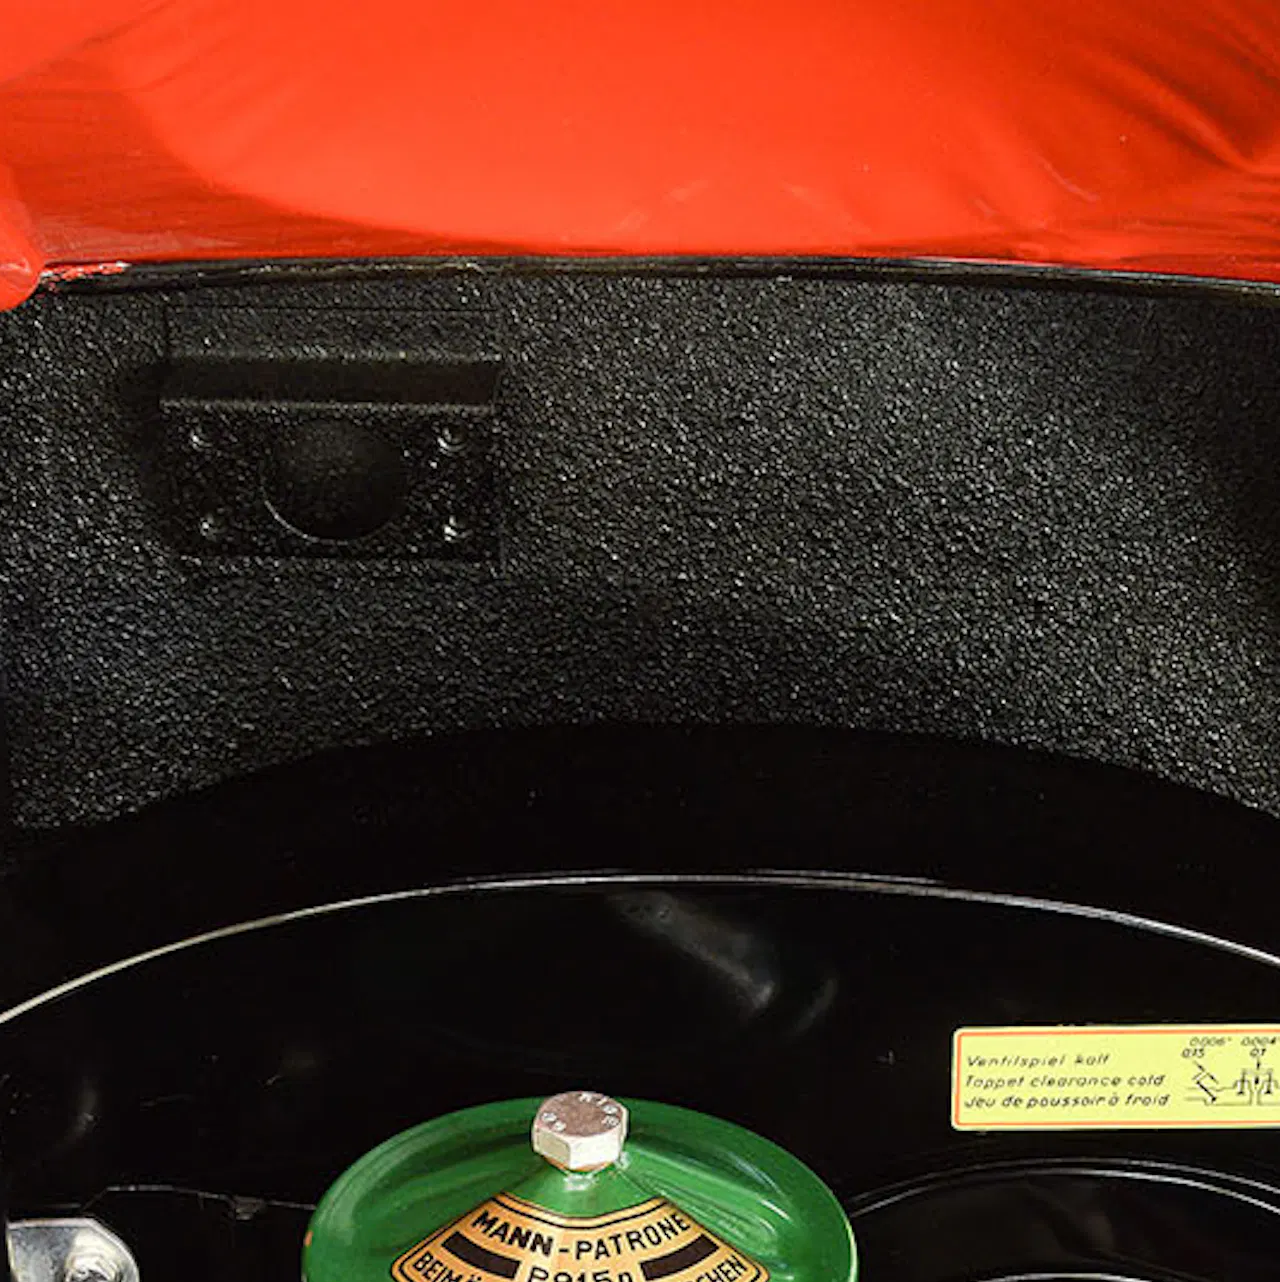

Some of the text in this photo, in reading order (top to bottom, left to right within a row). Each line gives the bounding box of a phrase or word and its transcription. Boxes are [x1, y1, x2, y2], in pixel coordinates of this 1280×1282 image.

[967, 1053, 1111, 1070] Ventilspiel kalt
[965, 1074, 1167, 1090] Tappet clearance cold
[964, 1096, 996, 1109] Jeu
[1001, 1095, 1022, 1108] de
[1025, 1095, 1107, 1110] poussoir
[1124, 1093, 1171, 1107] froid
